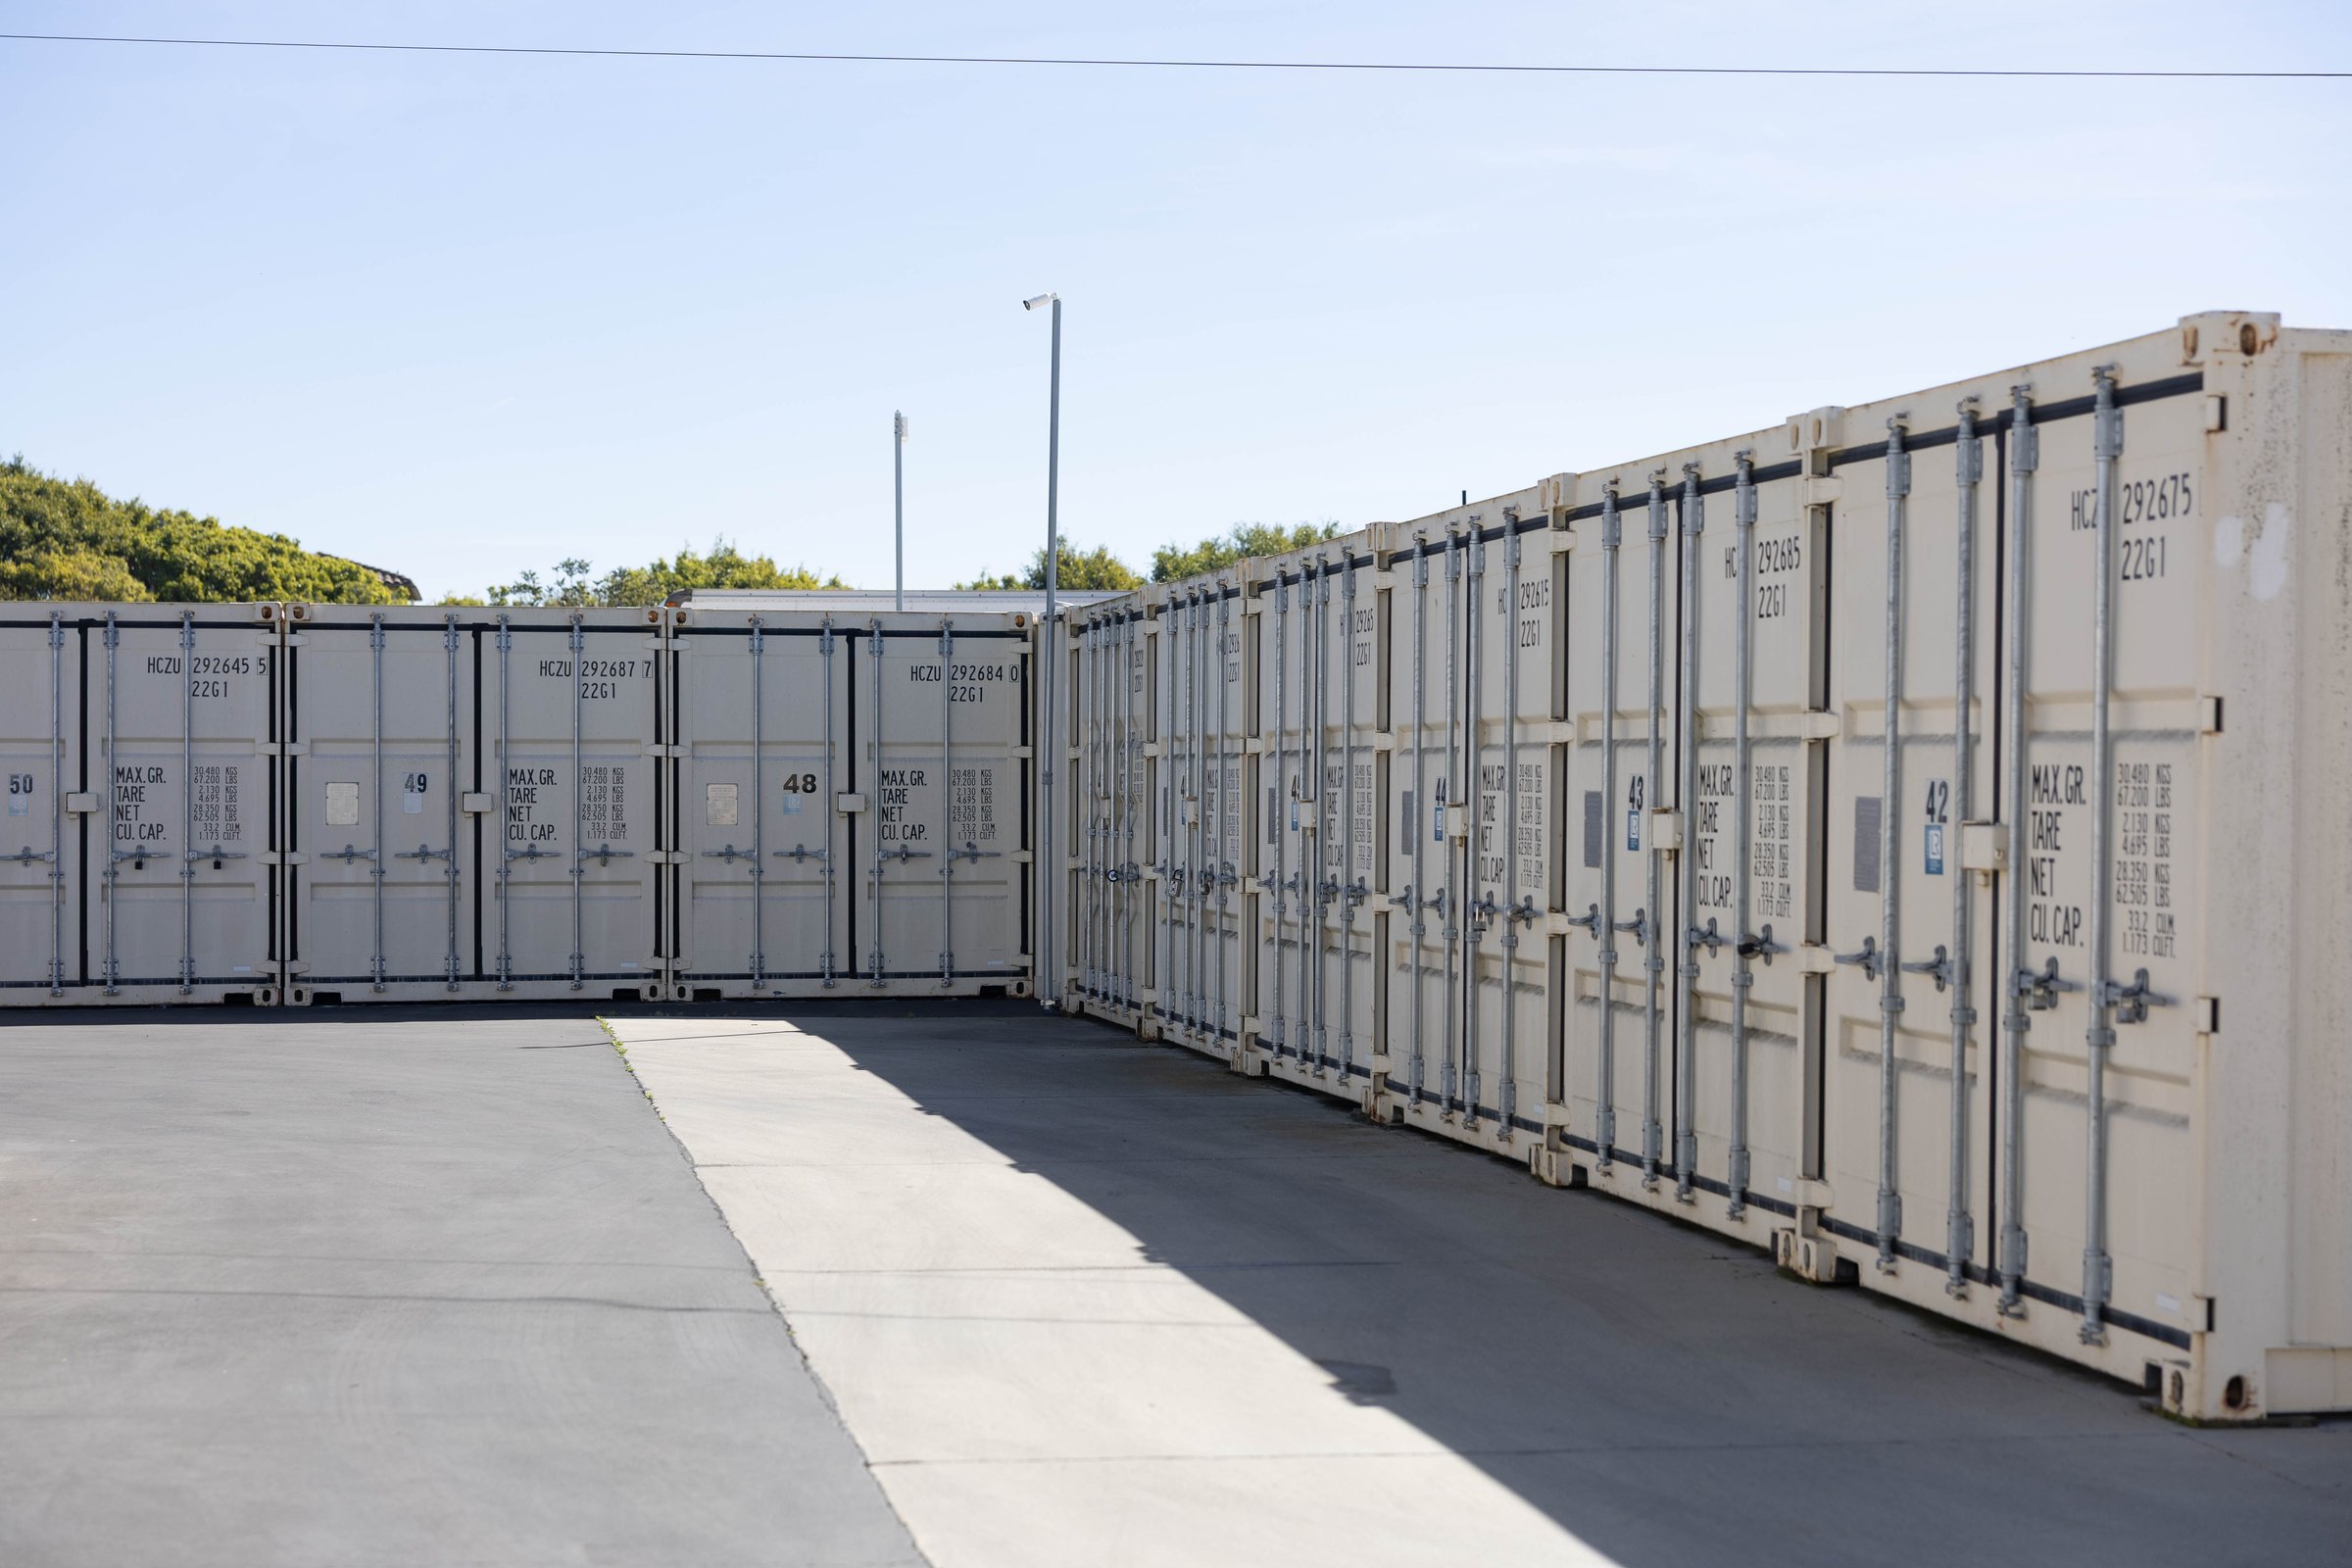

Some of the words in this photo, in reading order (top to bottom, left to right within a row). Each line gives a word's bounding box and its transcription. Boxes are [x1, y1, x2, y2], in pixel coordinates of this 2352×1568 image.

[2072, 488, 2097, 531] HCZ
[2123, 472, 2191, 524] 292675
[1725, 547, 1737, 578] HC
[1758, 536, 1800, 574] 292685
[2122, 535, 2165, 580] 22G1
[1521, 578, 1548, 610] 292615
[1758, 584, 1786, 618] 22G1
[1521, 619, 1540, 647] 22G1
[147, 657, 181, 674] HCZU
[193, 658, 250, 674] 292645
[259, 658, 267, 674] 5
[539, 661, 571, 676] HCZU
[582, 661, 635, 677] 292687
[644, 661, 651, 676] 7
[911, 665, 941, 681] HCZU
[951, 664, 1003, 681] 292684
[192, 680, 227, 698] 22G1
[582, 682, 615, 699] 22G1
[951, 686, 982, 702] 22G1
[194, 766, 220, 775] 30.480
[225, 766, 237, 775] KGS
[194, 775, 220, 784] 67.200
[582, 766, 608, 775] 30.480
[612, 767, 624, 776] KGS
[953, 769, 976, 778] 30.480
[981, 769, 992, 778] KGS
[2118, 762, 2149, 784] 30.480
[2156, 763, 2172, 785] KGS
[10, 774, 33, 794] 50
[404, 774, 427, 793] 49
[784, 774, 817, 794] 48
[1436, 778, 1446, 807] 44
[1629, 776, 1643, 810] 43
[116, 786, 145, 803] TARE
[198, 794, 220, 804] 4.695
[225, 794, 237, 804] LBS
[510, 788, 537, 804] TARE
[586, 794, 607, 804] 4.695
[612, 794, 623, 804] LBS
[882, 788, 907, 804] TARE
[1926, 780, 1948, 823] 42
[2117, 786, 2148, 808] 67.200
[2156, 786, 2171, 808] LBS
[116, 805, 139, 821] NET
[194, 804, 220, 813] 28.350
[225, 804, 237, 813] KGS
[510, 806, 531, 821] NET
[582, 804, 607, 812] 28.350
[612, 804, 623, 812] KGS
[582, 812, 607, 821] 62.505
[612, 812, 623, 821] LBS
[882, 807, 904, 821] NET
[953, 813, 976, 822] 62.505
[981, 813, 992, 822] LBS
[1483, 796, 1495, 821] TARE
[1699, 802, 1719, 833] TARE
[2031, 810, 2062, 851] TARE
[2123, 811, 2148, 833] 2.130
[2156, 813, 2170, 835] KGS
[1481, 826, 1493, 853] NET
[2123, 835, 2148, 857] 4.695
[2155, 836, 2170, 858] LBS
[1698, 839, 1713, 870] NET
[2031, 857, 2055, 897] NET
[2117, 860, 2148, 882] 28.350
[2155, 862, 2170, 884] KGS
[2117, 883, 2148, 906] 62.505
[2155, 886, 2170, 907] LBS
